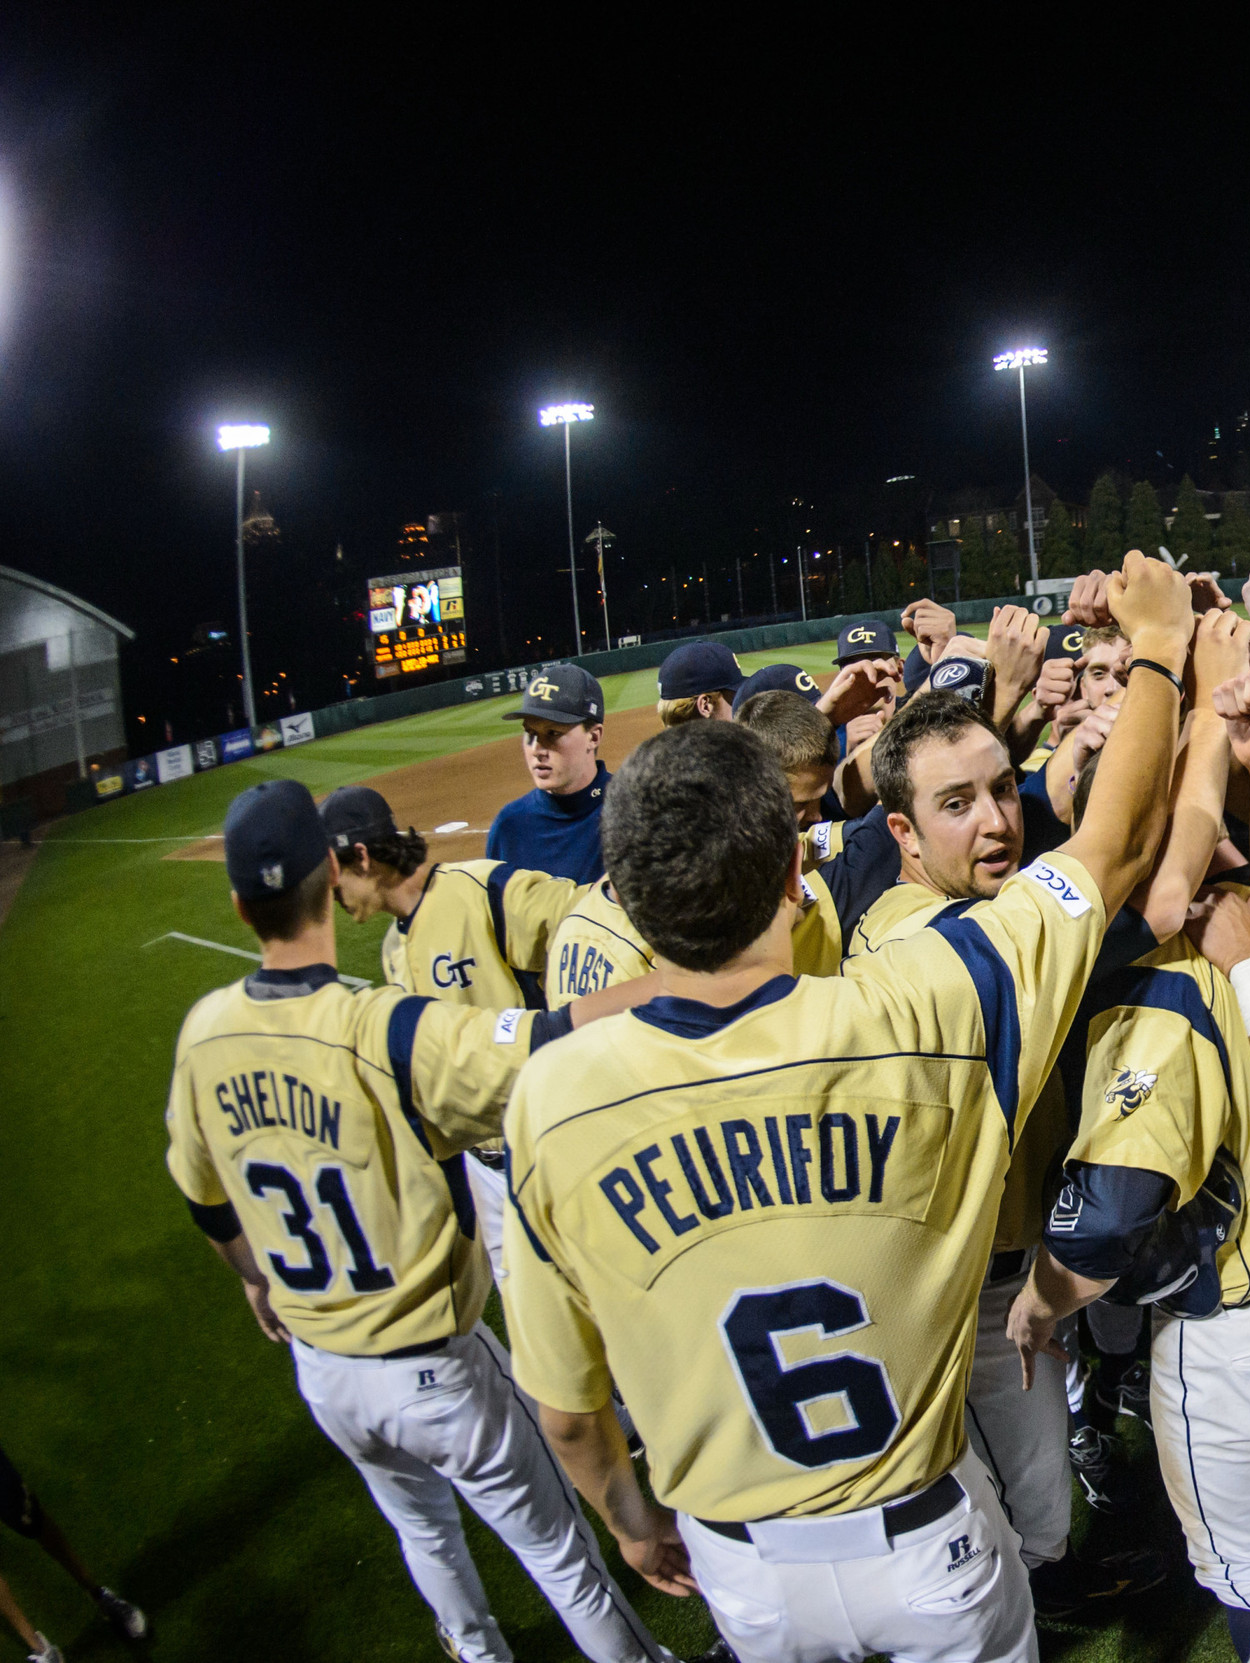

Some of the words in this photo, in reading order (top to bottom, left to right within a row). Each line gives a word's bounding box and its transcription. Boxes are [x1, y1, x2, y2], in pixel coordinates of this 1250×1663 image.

[848, 626, 876, 643] GT
[529, 677, 559, 701] GT
[432, 952, 476, 989] GT
[559, 943, 614, 997] PABST
[215, 1070, 341, 1150] SHELTON
[598, 1113, 901, 1255] PEURIFOY
[243, 1159, 396, 1293] 31
[418, 1369, 435, 1386] R
[717, 1276, 901, 1471] 6
[947, 1547, 981, 1573] RUSSELL
[948, 1534, 970, 1562] R
